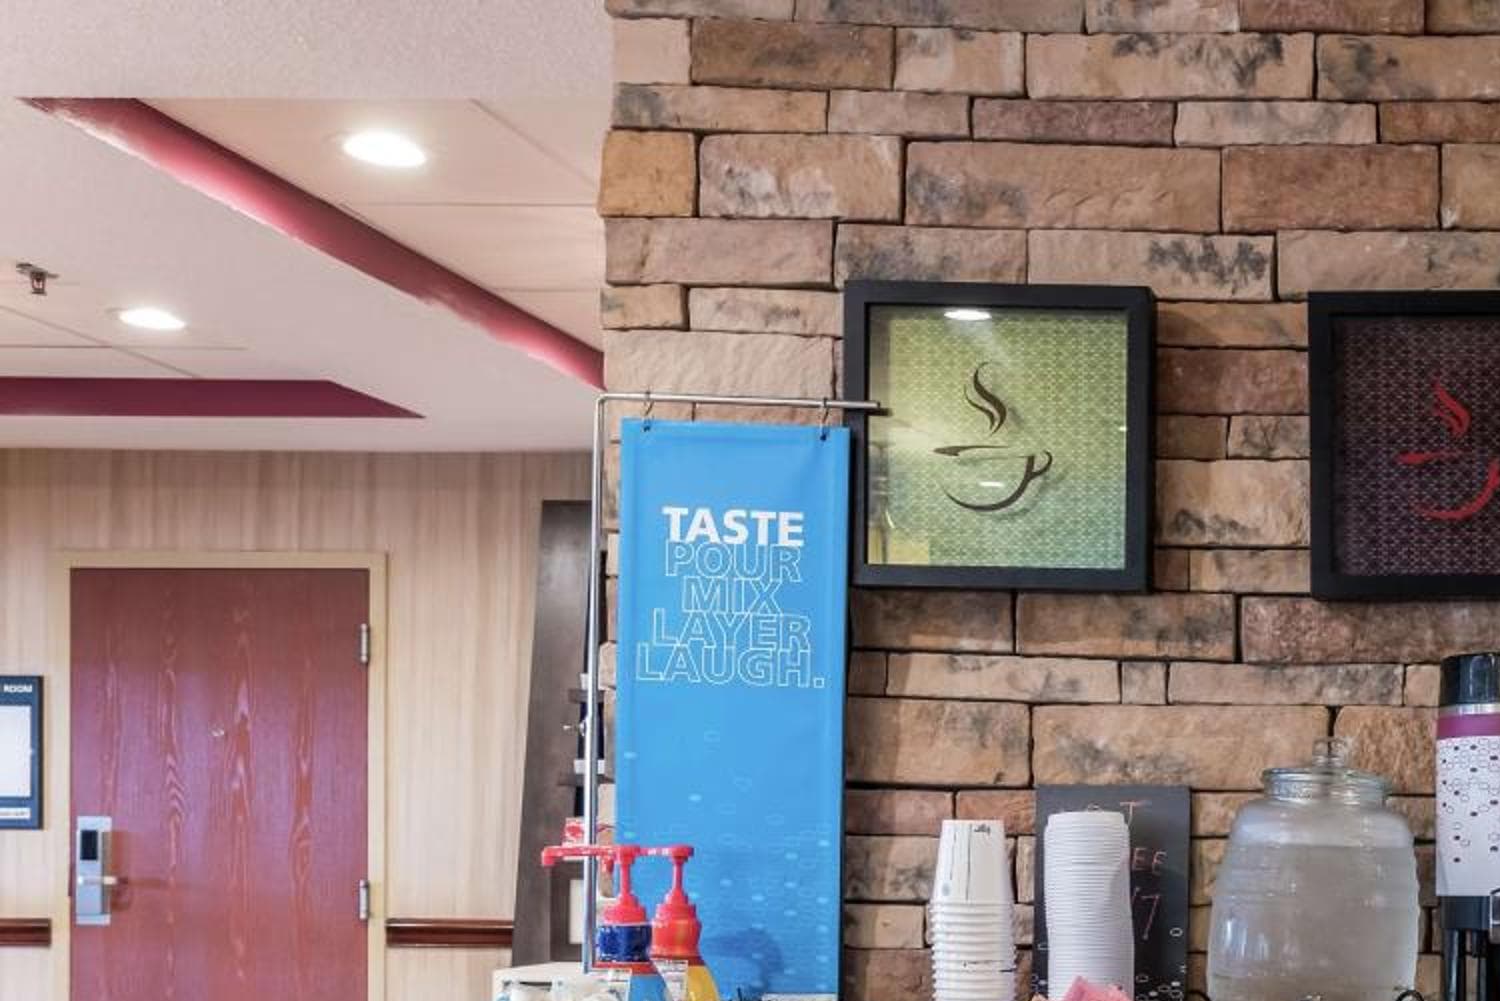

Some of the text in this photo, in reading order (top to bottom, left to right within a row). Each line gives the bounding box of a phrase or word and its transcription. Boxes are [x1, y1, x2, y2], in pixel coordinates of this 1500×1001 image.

[662, 506, 805, 547] TASTE
[665, 539, 802, 583] POUR
[682, 575, 782, 615] MIX
[653, 607, 811, 651] LAYER
[636, 642, 825, 688] LAUGH.
[3, 684, 33, 693] ROOM
